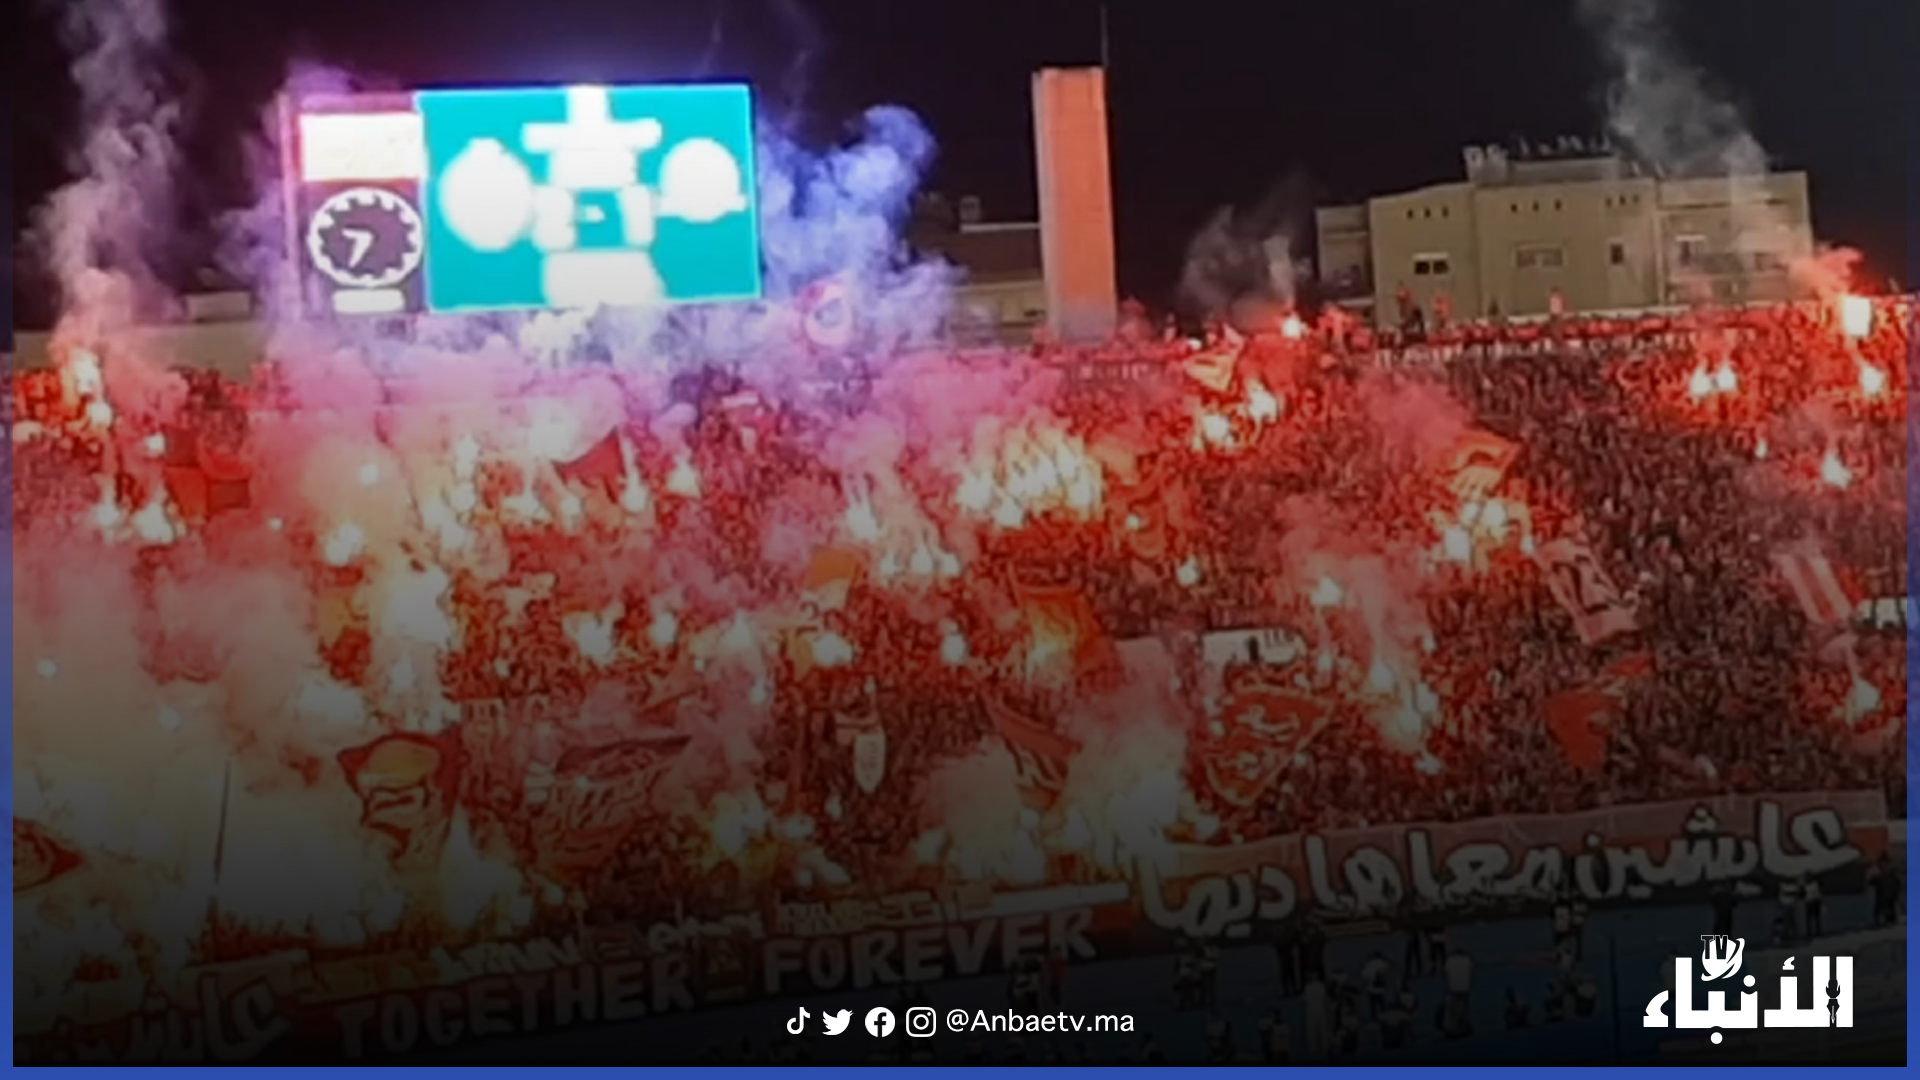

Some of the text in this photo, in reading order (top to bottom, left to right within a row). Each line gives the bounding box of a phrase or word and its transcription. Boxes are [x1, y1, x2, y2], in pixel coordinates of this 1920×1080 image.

[1141, 850, 1296, 938] ديما
[1574, 801, 1862, 899] عايشين
[333, 954, 696, 1060] TOGETHER
[763, 906, 1097, 995] FOREVER
